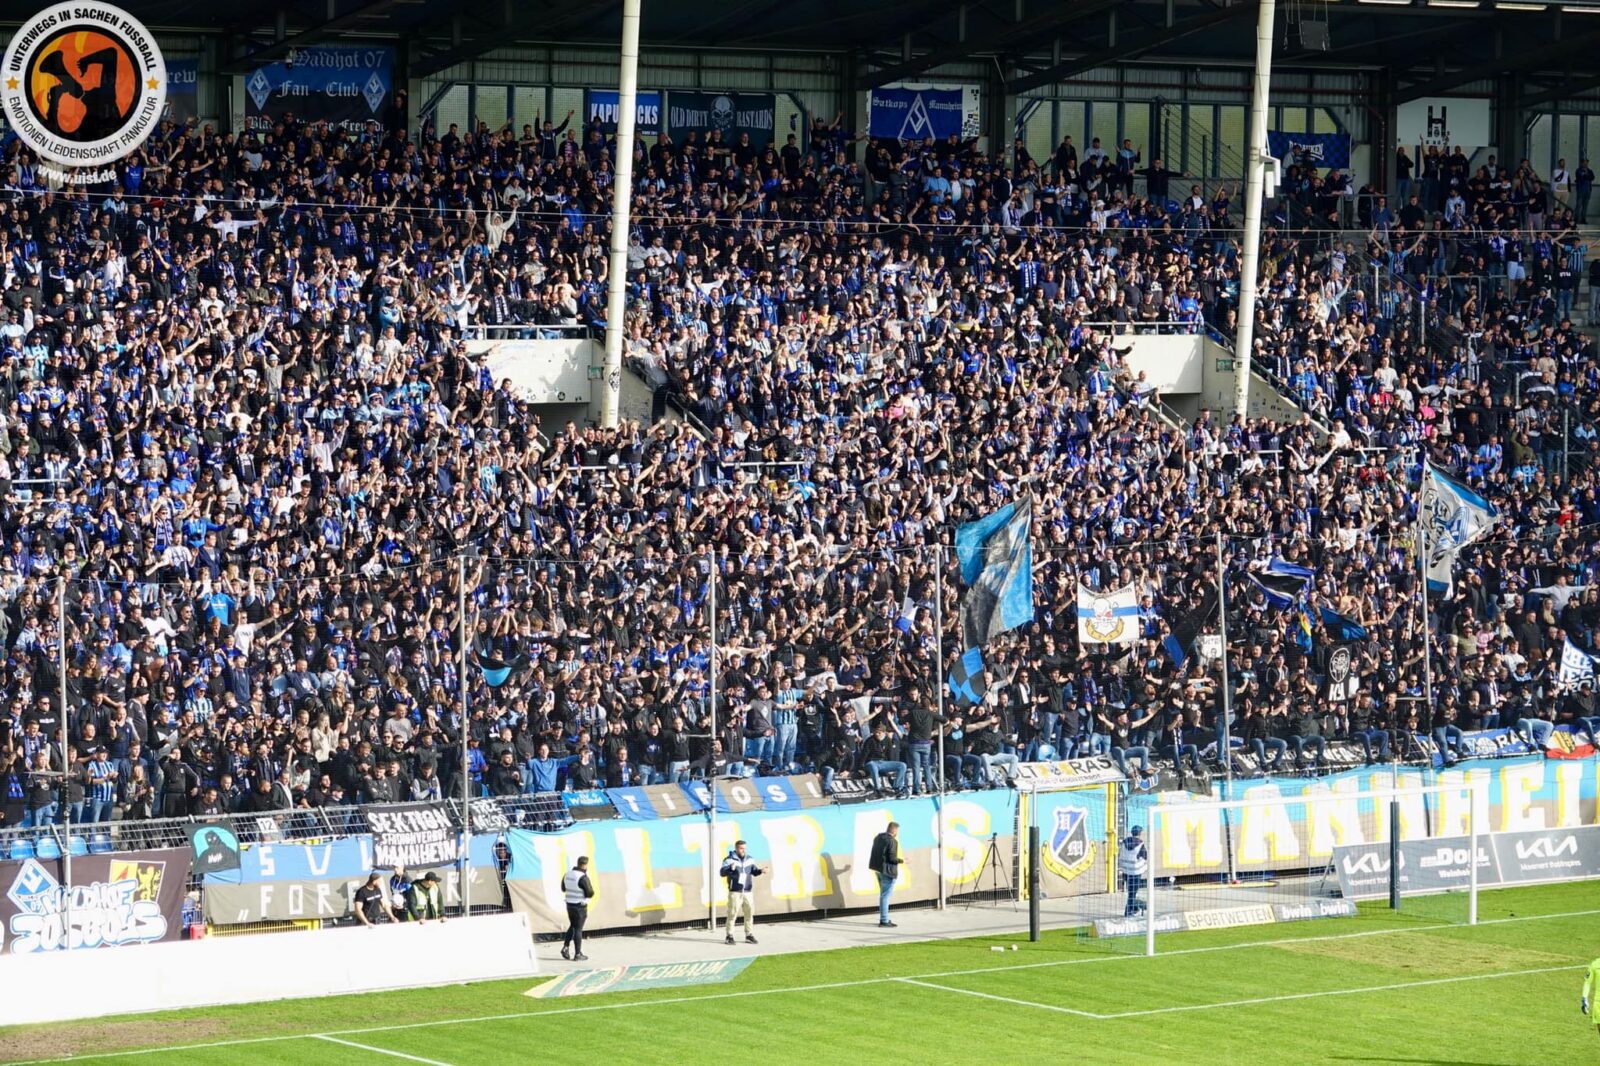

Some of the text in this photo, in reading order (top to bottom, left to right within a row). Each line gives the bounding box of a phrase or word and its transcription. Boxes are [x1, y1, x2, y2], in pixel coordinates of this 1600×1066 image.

[293, 50, 386, 71] Waldhof 07
[275, 80, 310, 98] Fan
[325, 81, 359, 97] Club
[671, 106, 709, 129] OLD DIRTY
[736, 108, 773, 130] BASTARDS
[1069, 756, 1113, 775] RAS
[260, 818, 275, 832] 12
[367, 806, 453, 834] SEKTION
[1160, 761, 1600, 868] MANNHEI
[375, 839, 457, 867] MANNHEIM
[533, 800, 992, 914] ULTRAS
[1515, 835, 1578, 861] KIA
[1342, 850, 1406, 875] KIA
[1188, 907, 1273, 928] SPORTWETTEN
[1281, 903, 1312, 919] bwin
[1319, 901, 1350, 917] bwin
